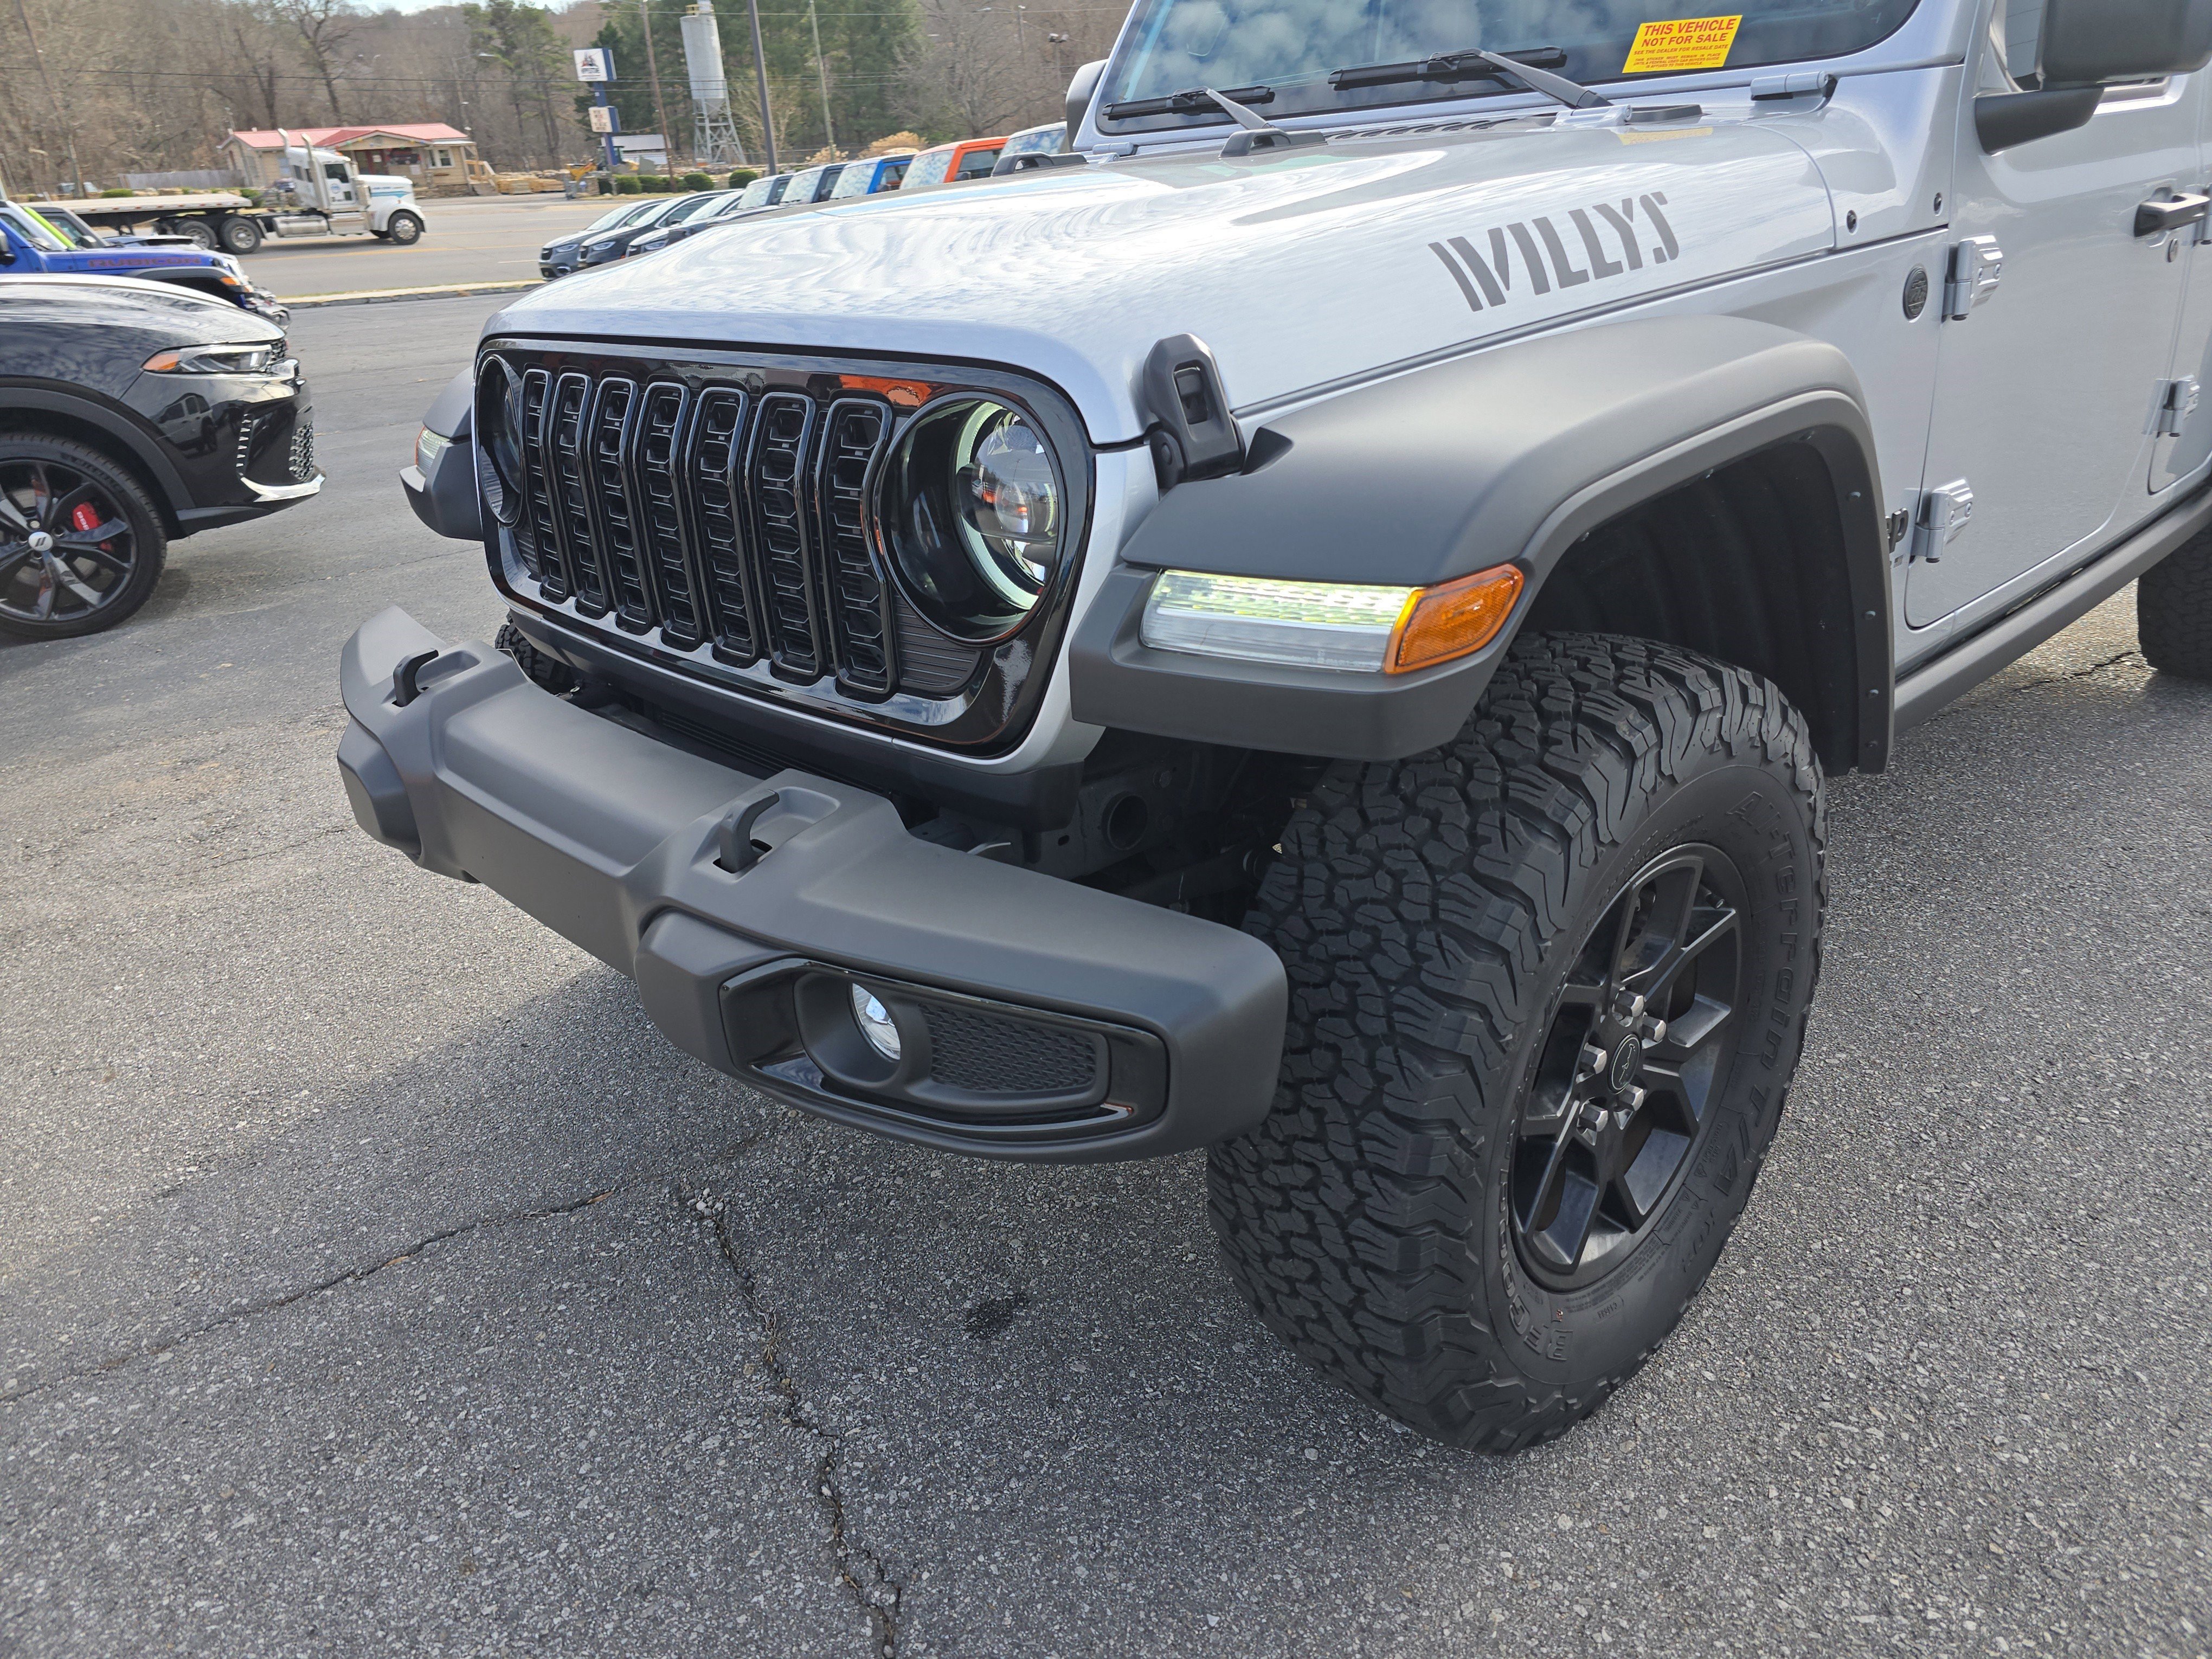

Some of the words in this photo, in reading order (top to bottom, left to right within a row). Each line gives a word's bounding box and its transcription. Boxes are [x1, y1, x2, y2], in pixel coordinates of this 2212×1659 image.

[1644, 23, 1674, 36] THIS
[1677, 18, 1737, 34] VEHICLE
[1641, 37, 1666, 47] NOT
[1668, 35, 1693, 45] FOR
[1696, 33, 1729, 43] SALE
[1428, 191, 1679, 312] WILLYS
[88, 258, 202, 267] RUBICON
[1725, 790, 1799, 1071] All-Terrain
